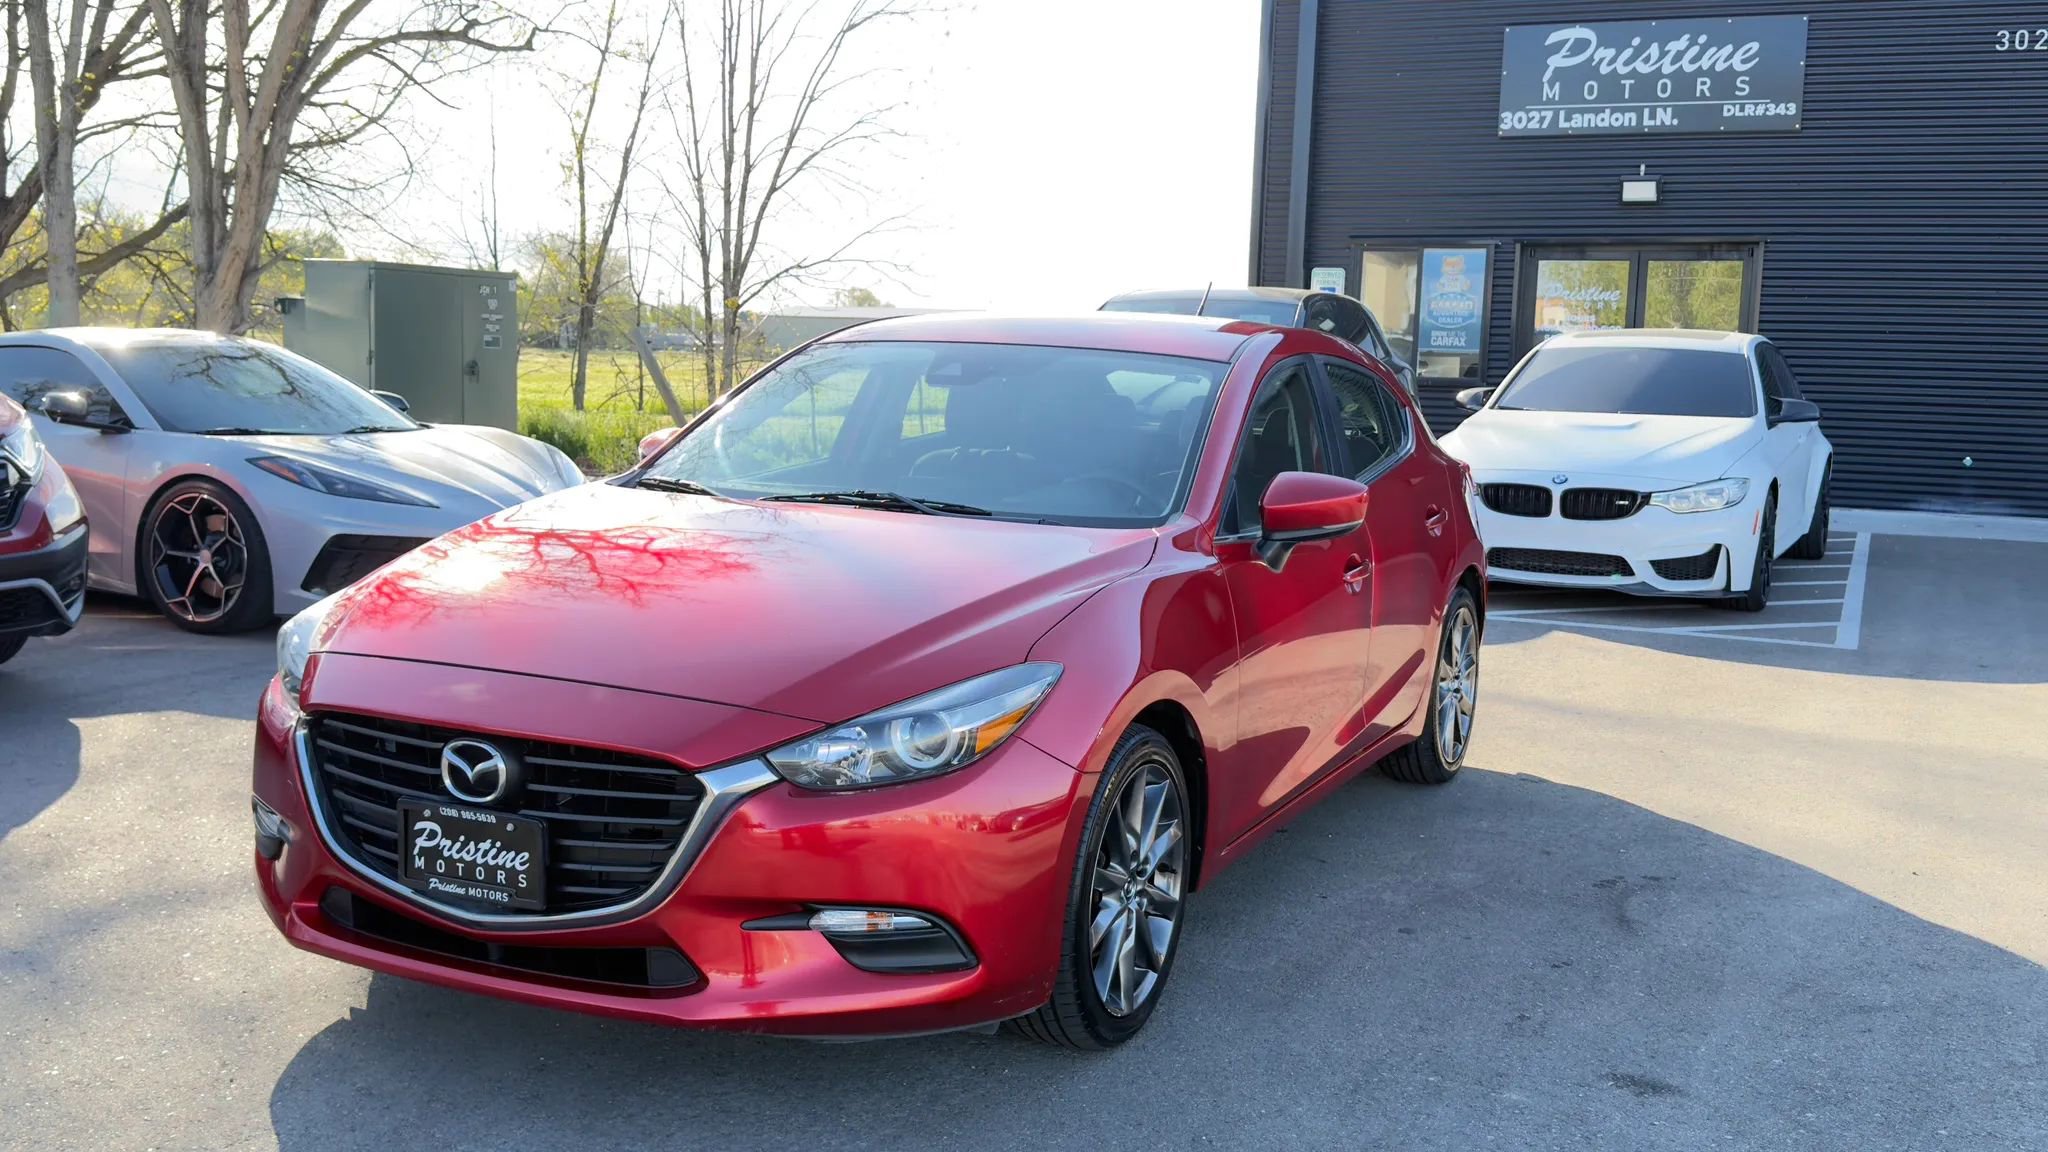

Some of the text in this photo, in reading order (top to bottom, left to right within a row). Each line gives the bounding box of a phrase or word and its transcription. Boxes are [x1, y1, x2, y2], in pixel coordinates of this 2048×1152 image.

[1995, 29, 2048, 51] 302
[1542, 26, 1760, 82] Pristine
[1542, 77, 1751, 102] MOTORS
[1500, 107, 1679, 130] 3027 Landon LN.
[1723, 102, 1797, 117] DLR#343
[1542, 283, 1622, 302] Pristine
[1431, 336, 1467, 347] CARFAX
[413, 820, 530, 871] Pristine
[414, 855, 528, 888] MOTORS
[428, 877, 509, 902] Pristine MOTORS
